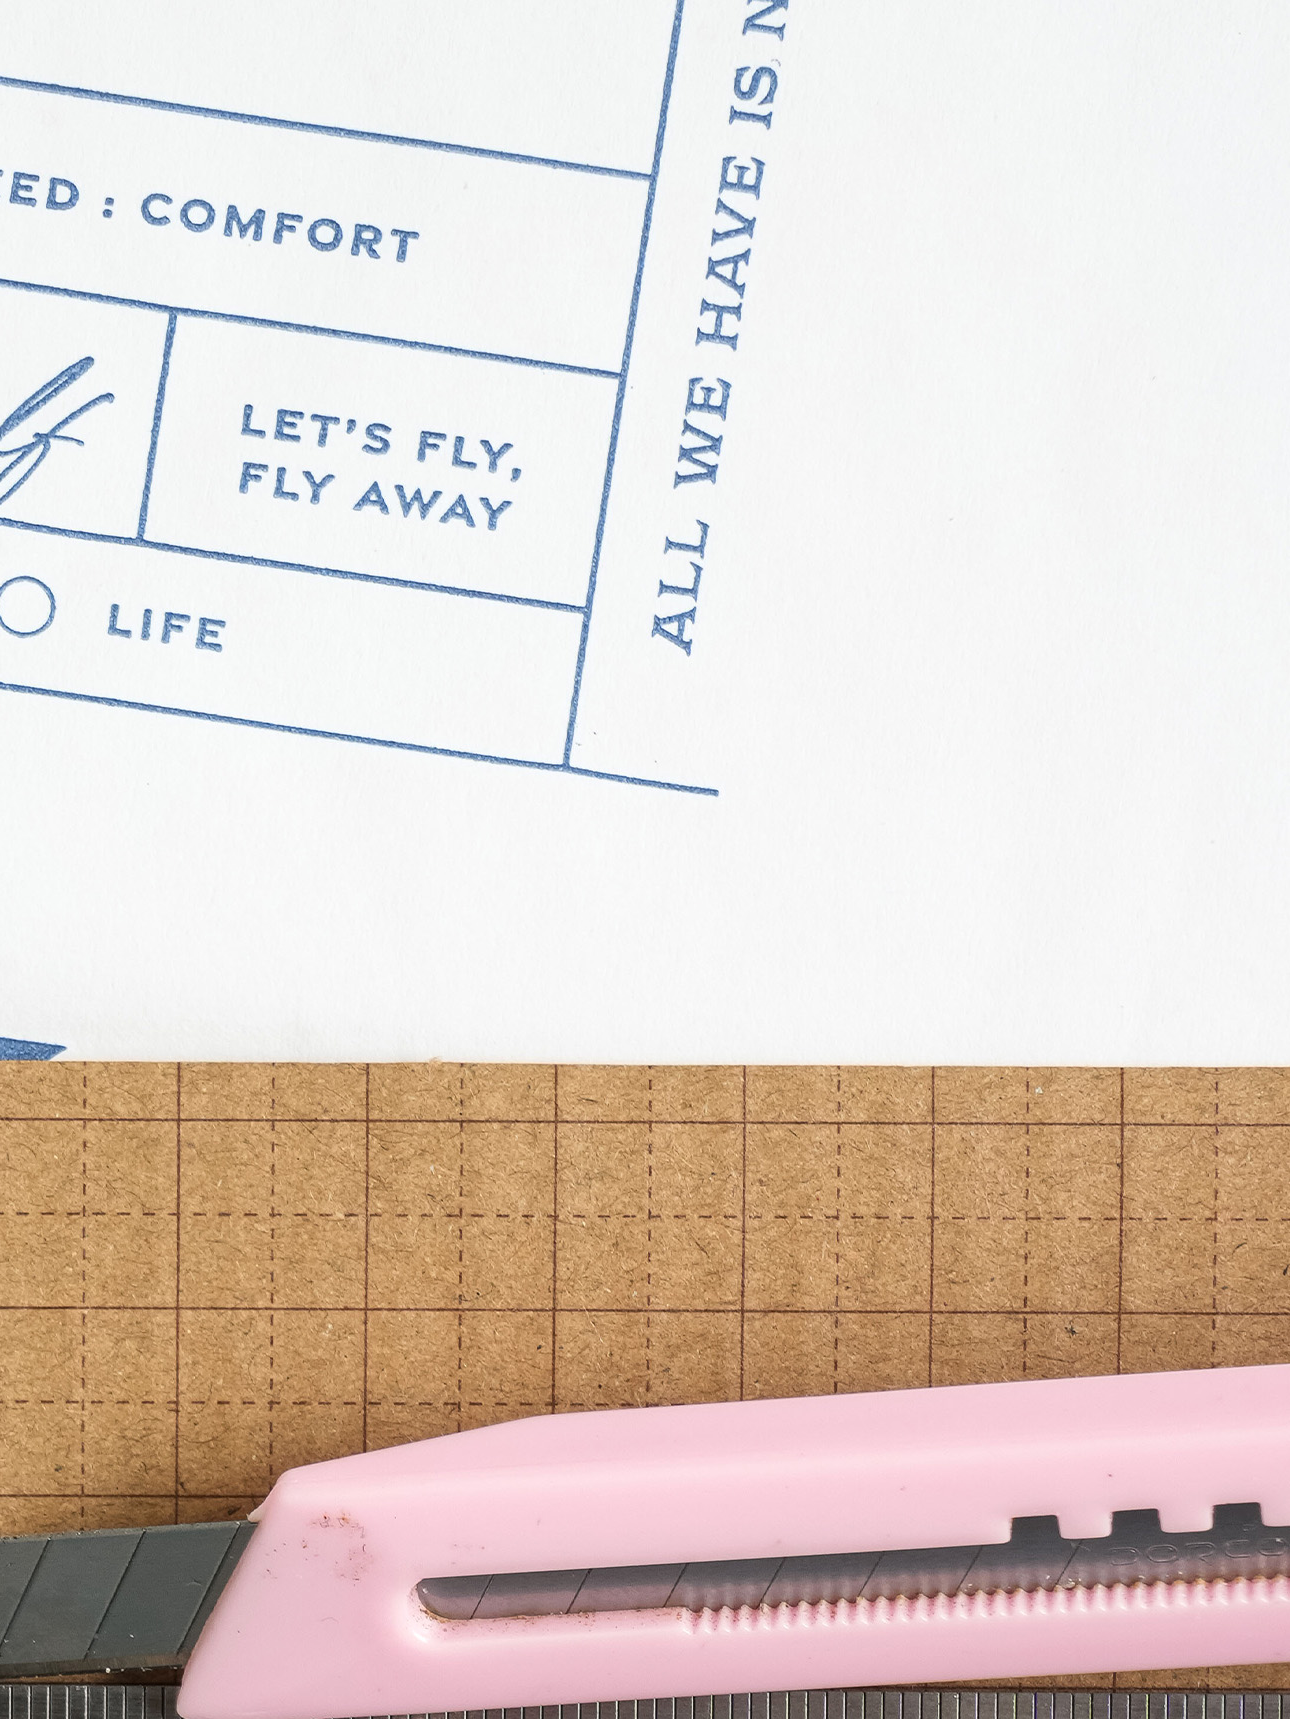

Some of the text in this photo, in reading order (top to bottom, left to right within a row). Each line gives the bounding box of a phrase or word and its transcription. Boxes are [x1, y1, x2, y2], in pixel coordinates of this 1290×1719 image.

[729, 66, 778, 128] IS
[142, 193, 419, 261] COMFORT
[696, 156, 765, 350] HAVE
[242, 404, 521, 480] LET'S FLY,
[675, 377, 732, 486] WE
[239, 462, 512, 530] FLY AWAY
[652, 520, 710, 655] ALL
[108, 604, 226, 651] LIFE
[1108, 1537, 1289, 1567] DORCO
